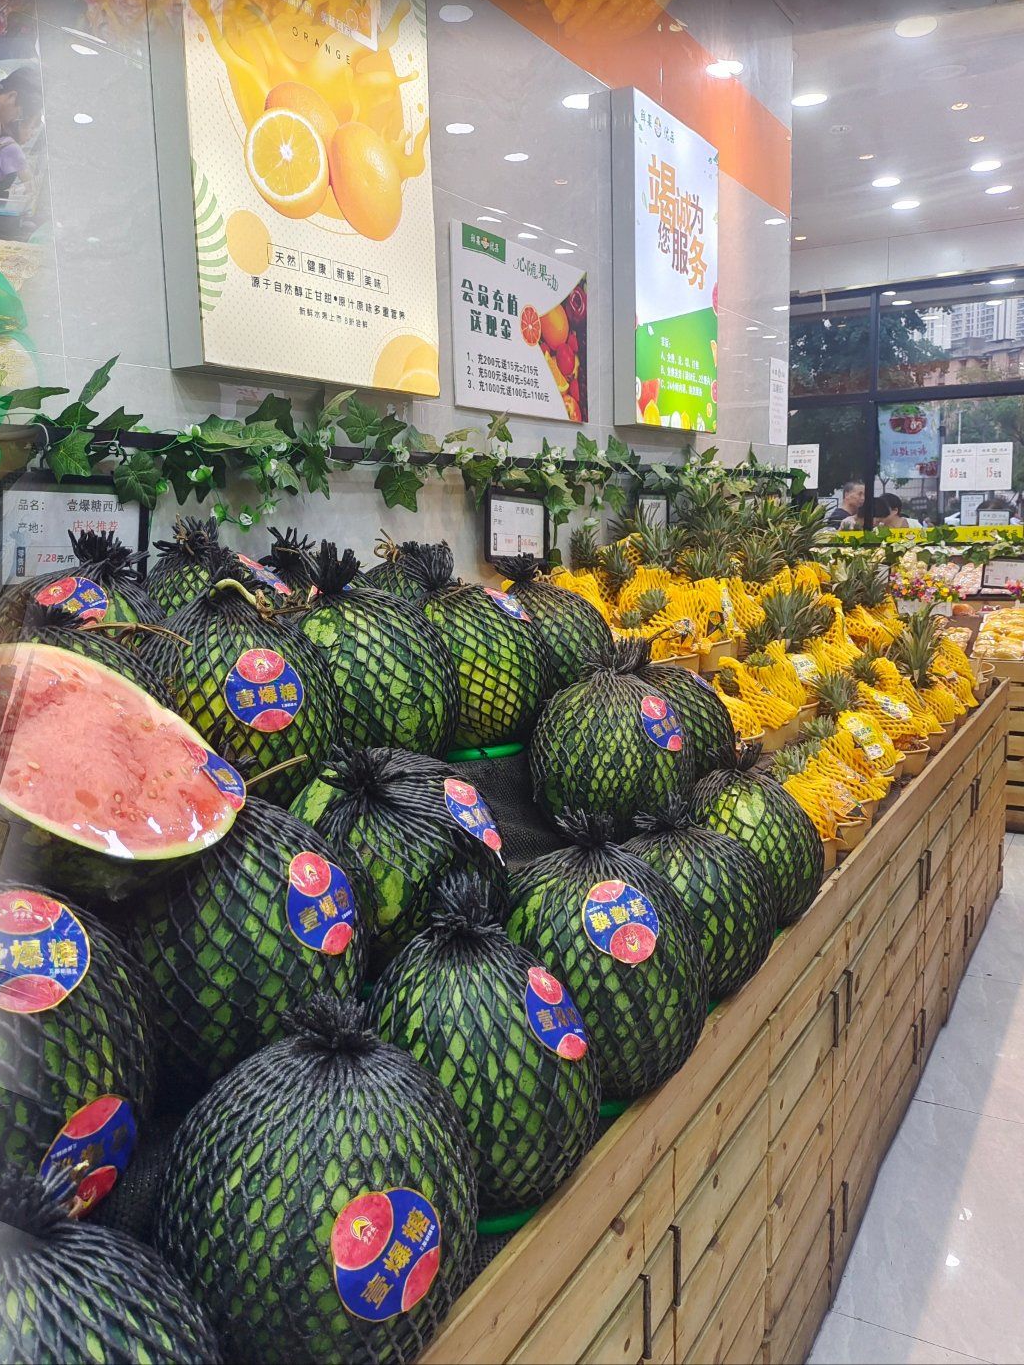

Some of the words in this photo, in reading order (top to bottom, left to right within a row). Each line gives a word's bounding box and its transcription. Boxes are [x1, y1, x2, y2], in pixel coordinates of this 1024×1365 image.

[291, 26, 351, 65] ORANGE
[276, 251, 297, 266] 天然
[307, 259, 326, 275] 健康
[336, 268, 355, 283] 新鲜
[364, 275, 382, 289] 美味
[461, 279, 518, 317] 会员充值
[470, 309, 513, 341] 送现金
[66, 498, 125, 512] 壹爆糖西瓜
[72, 520, 119, 533] 店长推荐
[37, 553, 75, 563] 7.28元/斤
[236, 682, 298, 709] 壹爆糖
[588, 896, 647, 933] 壹爆糖
[360, 1207, 431, 1311] 壹爆糖
